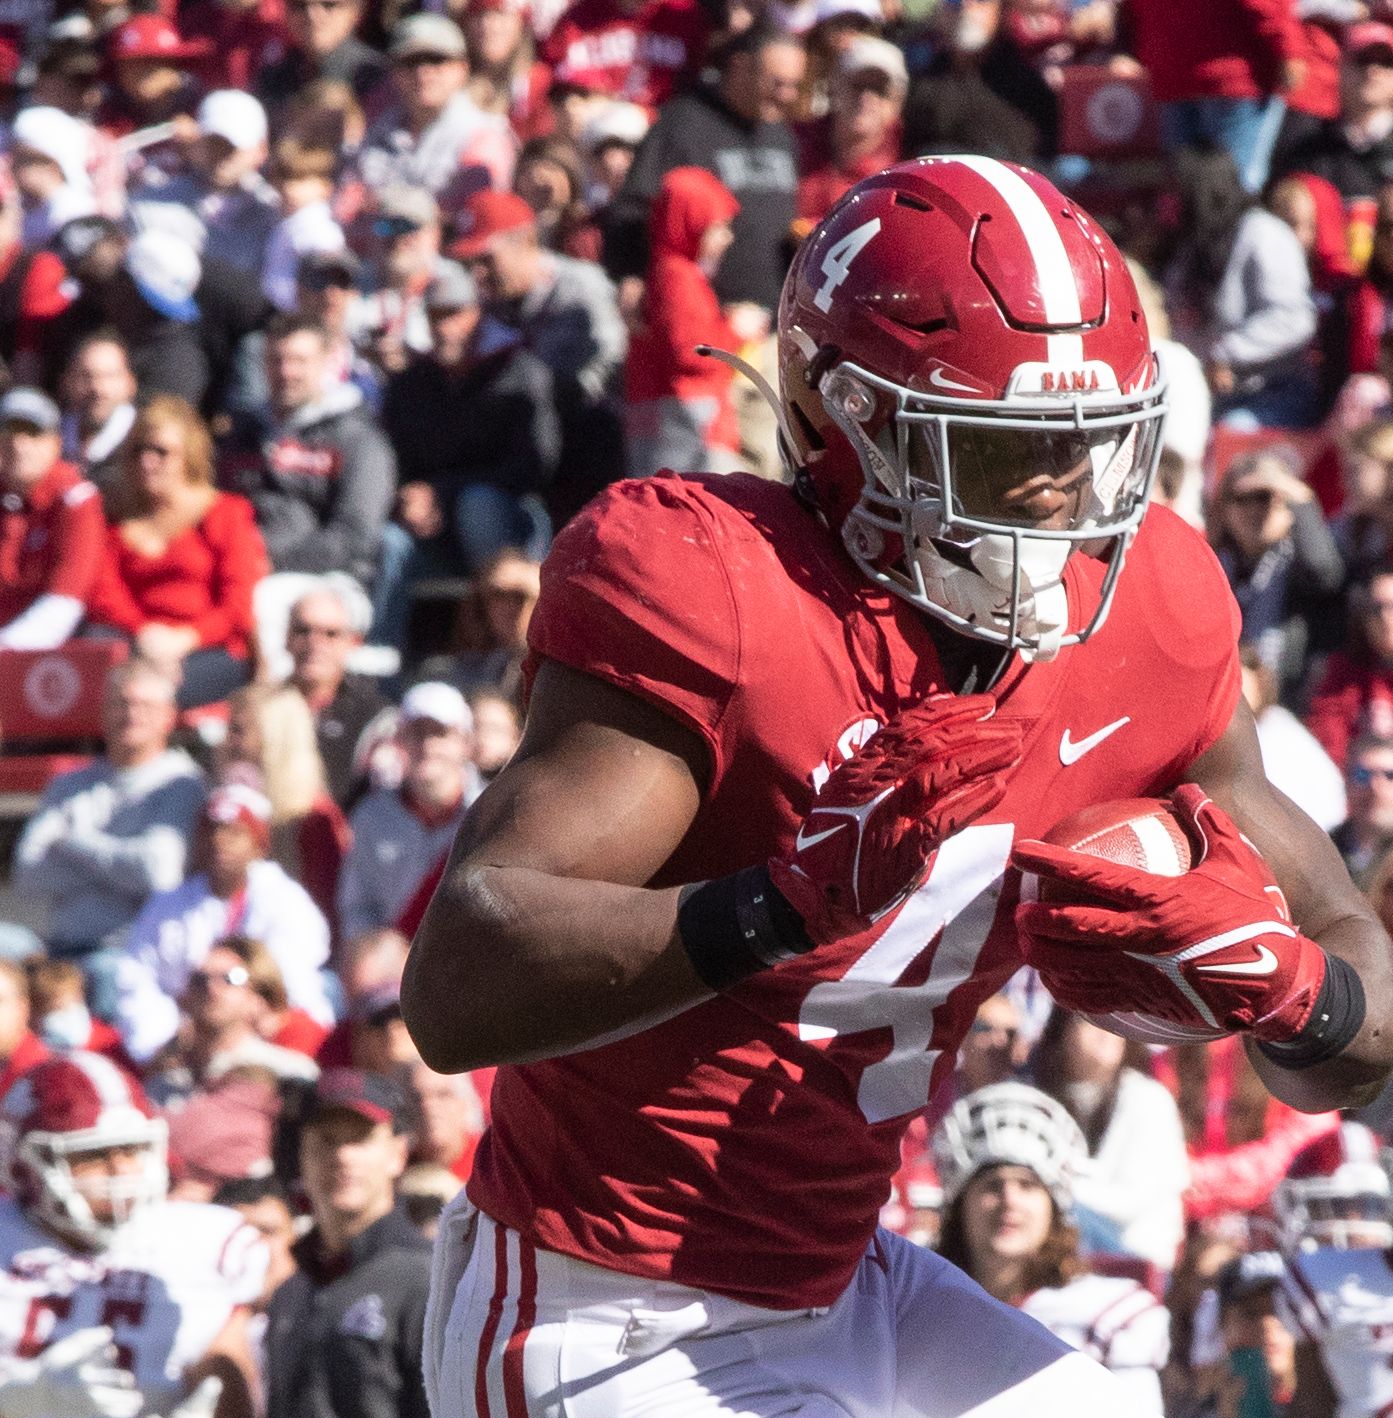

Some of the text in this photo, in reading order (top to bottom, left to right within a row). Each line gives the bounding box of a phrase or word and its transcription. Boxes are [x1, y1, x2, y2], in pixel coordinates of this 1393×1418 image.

[813, 217, 881, 314] 4
[1041, 370, 1099, 391] BAMA
[799, 823, 1014, 1125] 4
